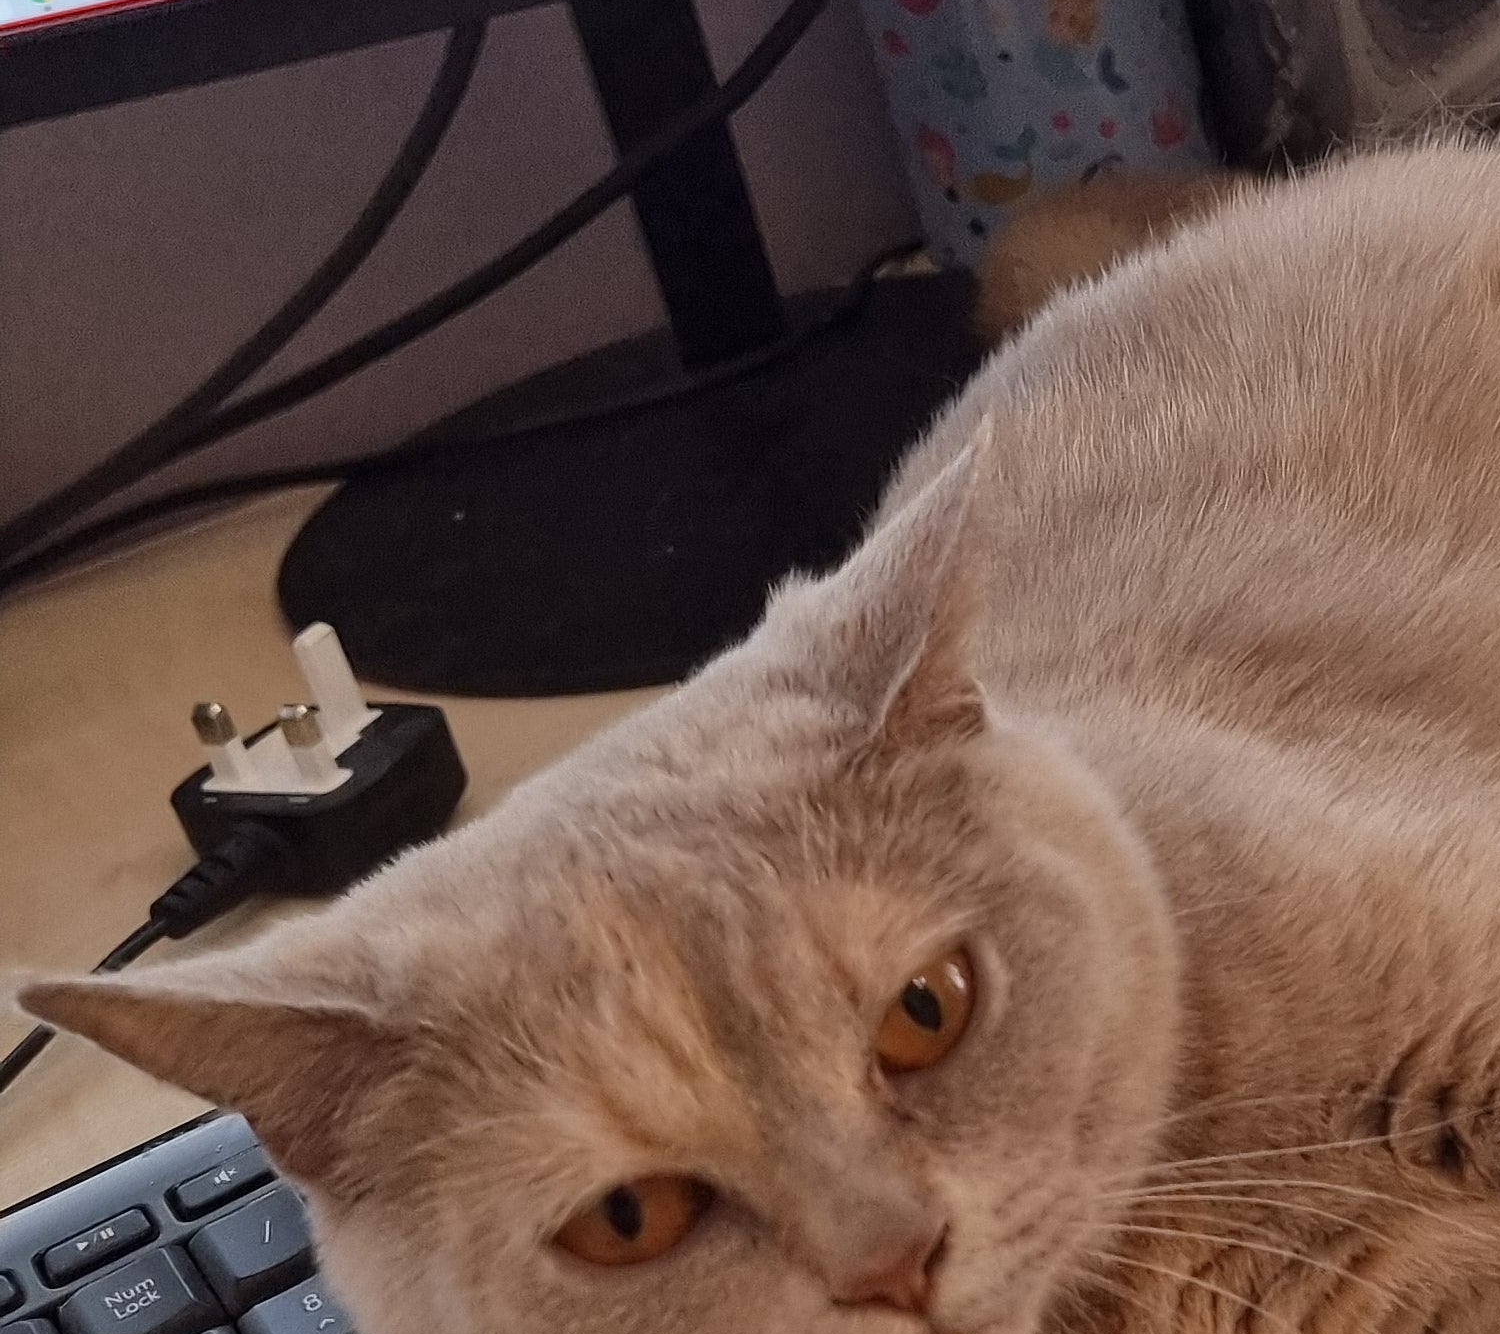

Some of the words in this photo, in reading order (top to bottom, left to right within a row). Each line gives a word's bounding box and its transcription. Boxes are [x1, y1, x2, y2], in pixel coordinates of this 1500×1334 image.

[104, 1277, 156, 1309] Num
[112, 1290, 161, 1320] Lock
[302, 1293, 322, 1312] 8
